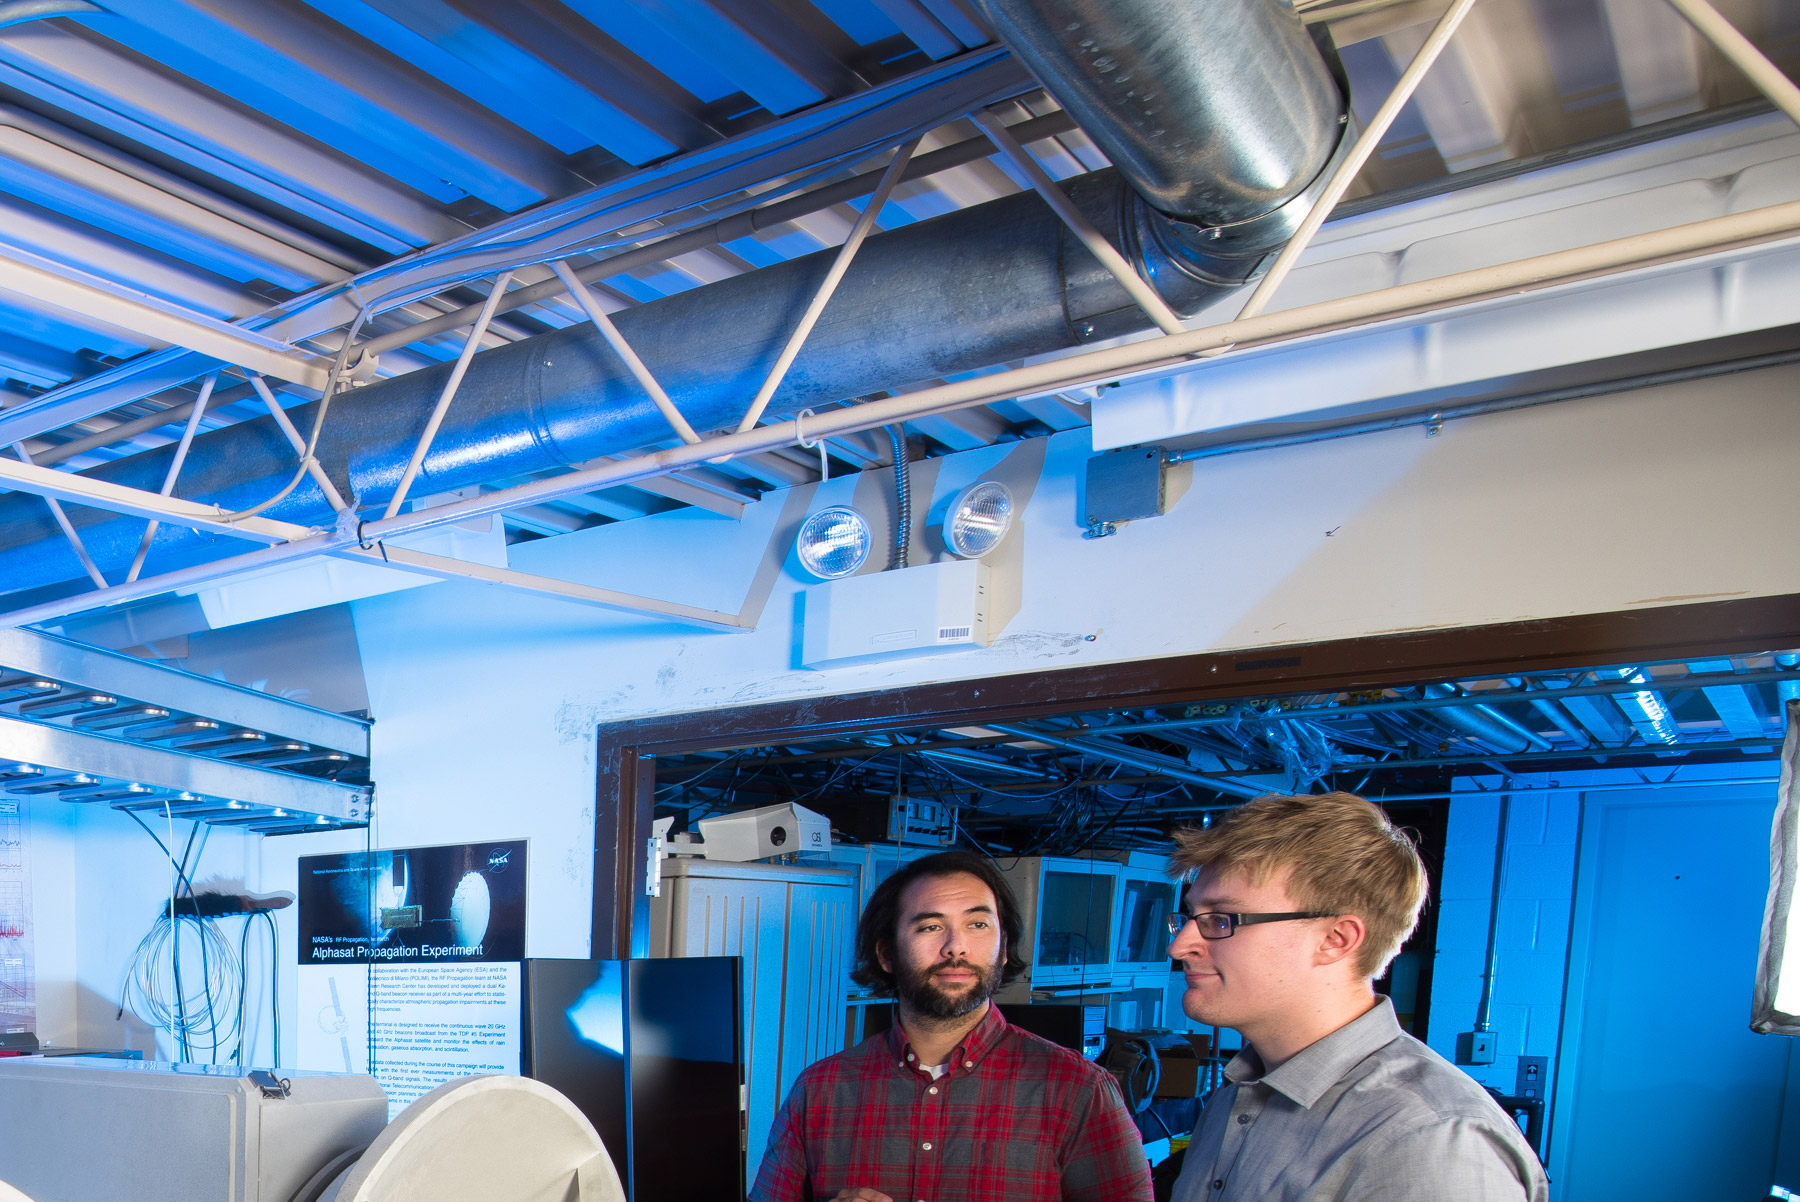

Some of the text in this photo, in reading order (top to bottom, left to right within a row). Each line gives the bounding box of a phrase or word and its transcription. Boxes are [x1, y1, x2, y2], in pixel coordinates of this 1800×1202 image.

[312, 943, 484, 960] Alphasat Propagation Experiment
